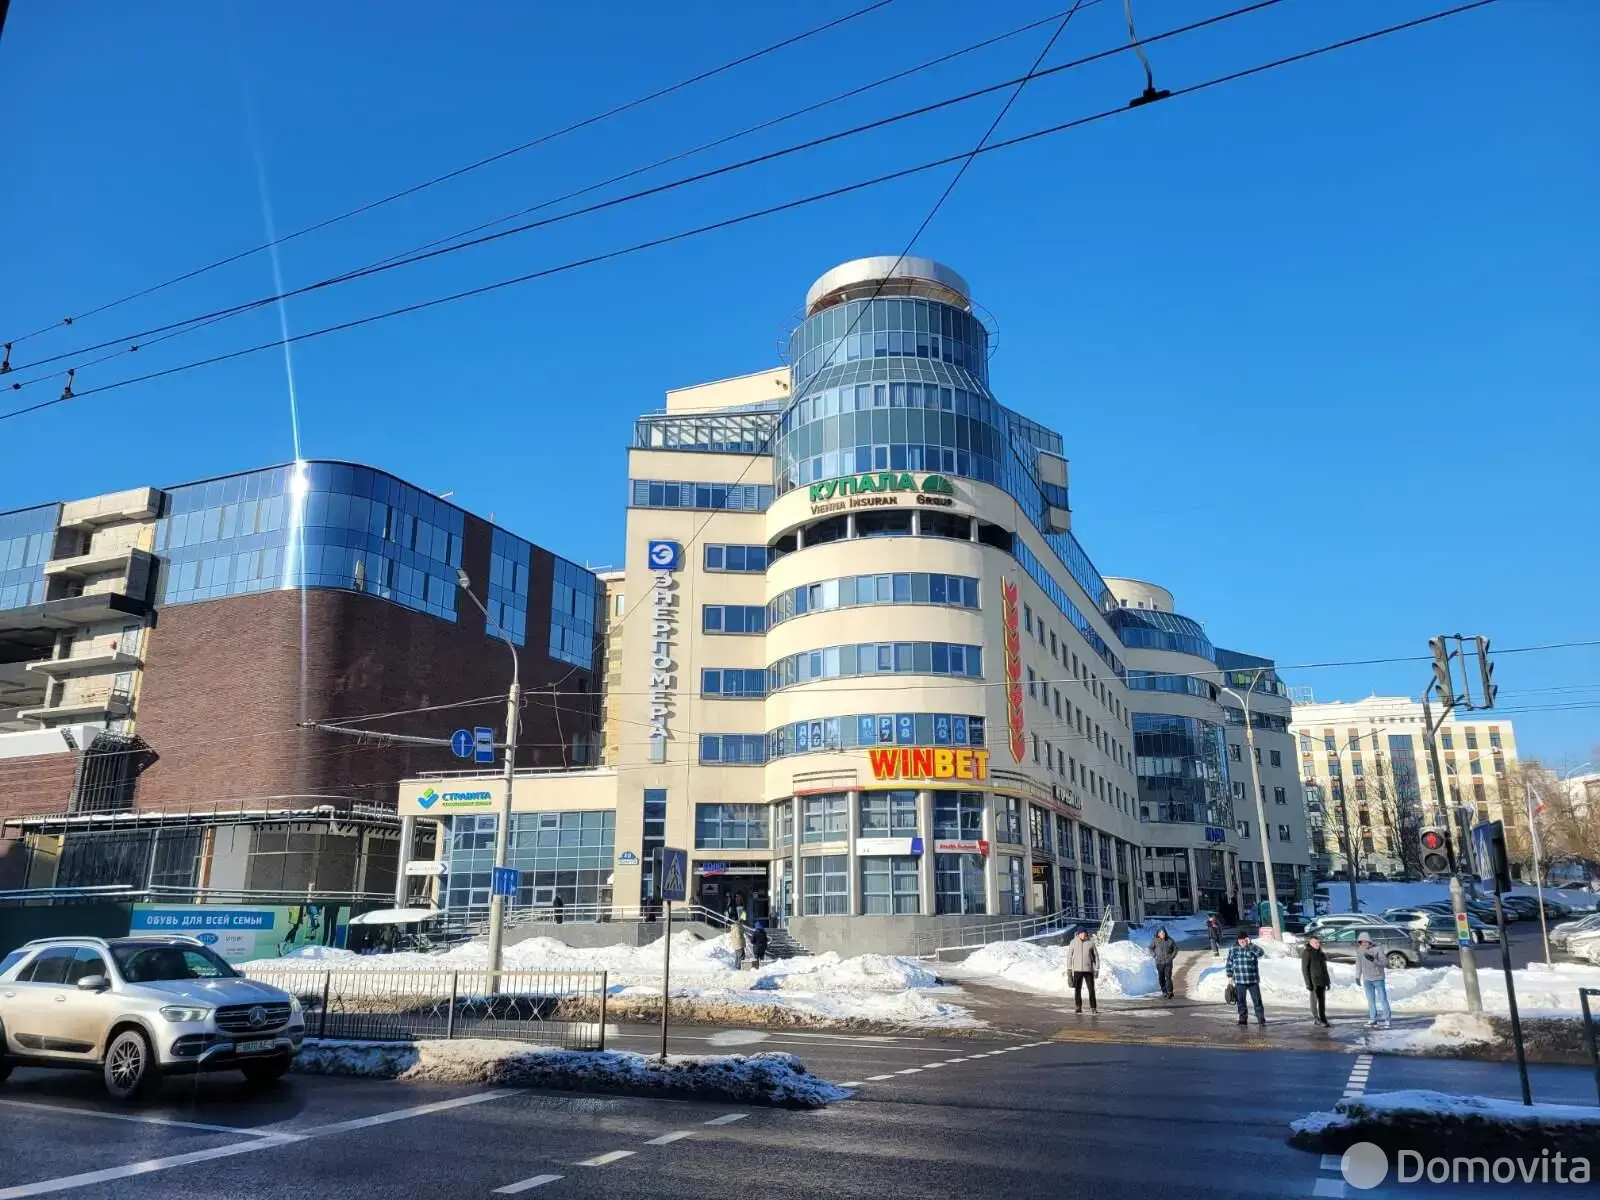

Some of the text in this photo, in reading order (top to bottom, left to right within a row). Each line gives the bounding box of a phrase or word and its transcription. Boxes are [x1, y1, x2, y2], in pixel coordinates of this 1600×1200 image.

[809, 472, 919, 502] КУПАЛА
[811, 500, 846, 515] VIENNA
[868, 747, 990, 780] WINBET
[441, 791, 492, 801] СТРАВИТА
[146, 914, 263, 926] ОБУВЬ ДЛЯ ВСЕЙ СЕМЬИ
